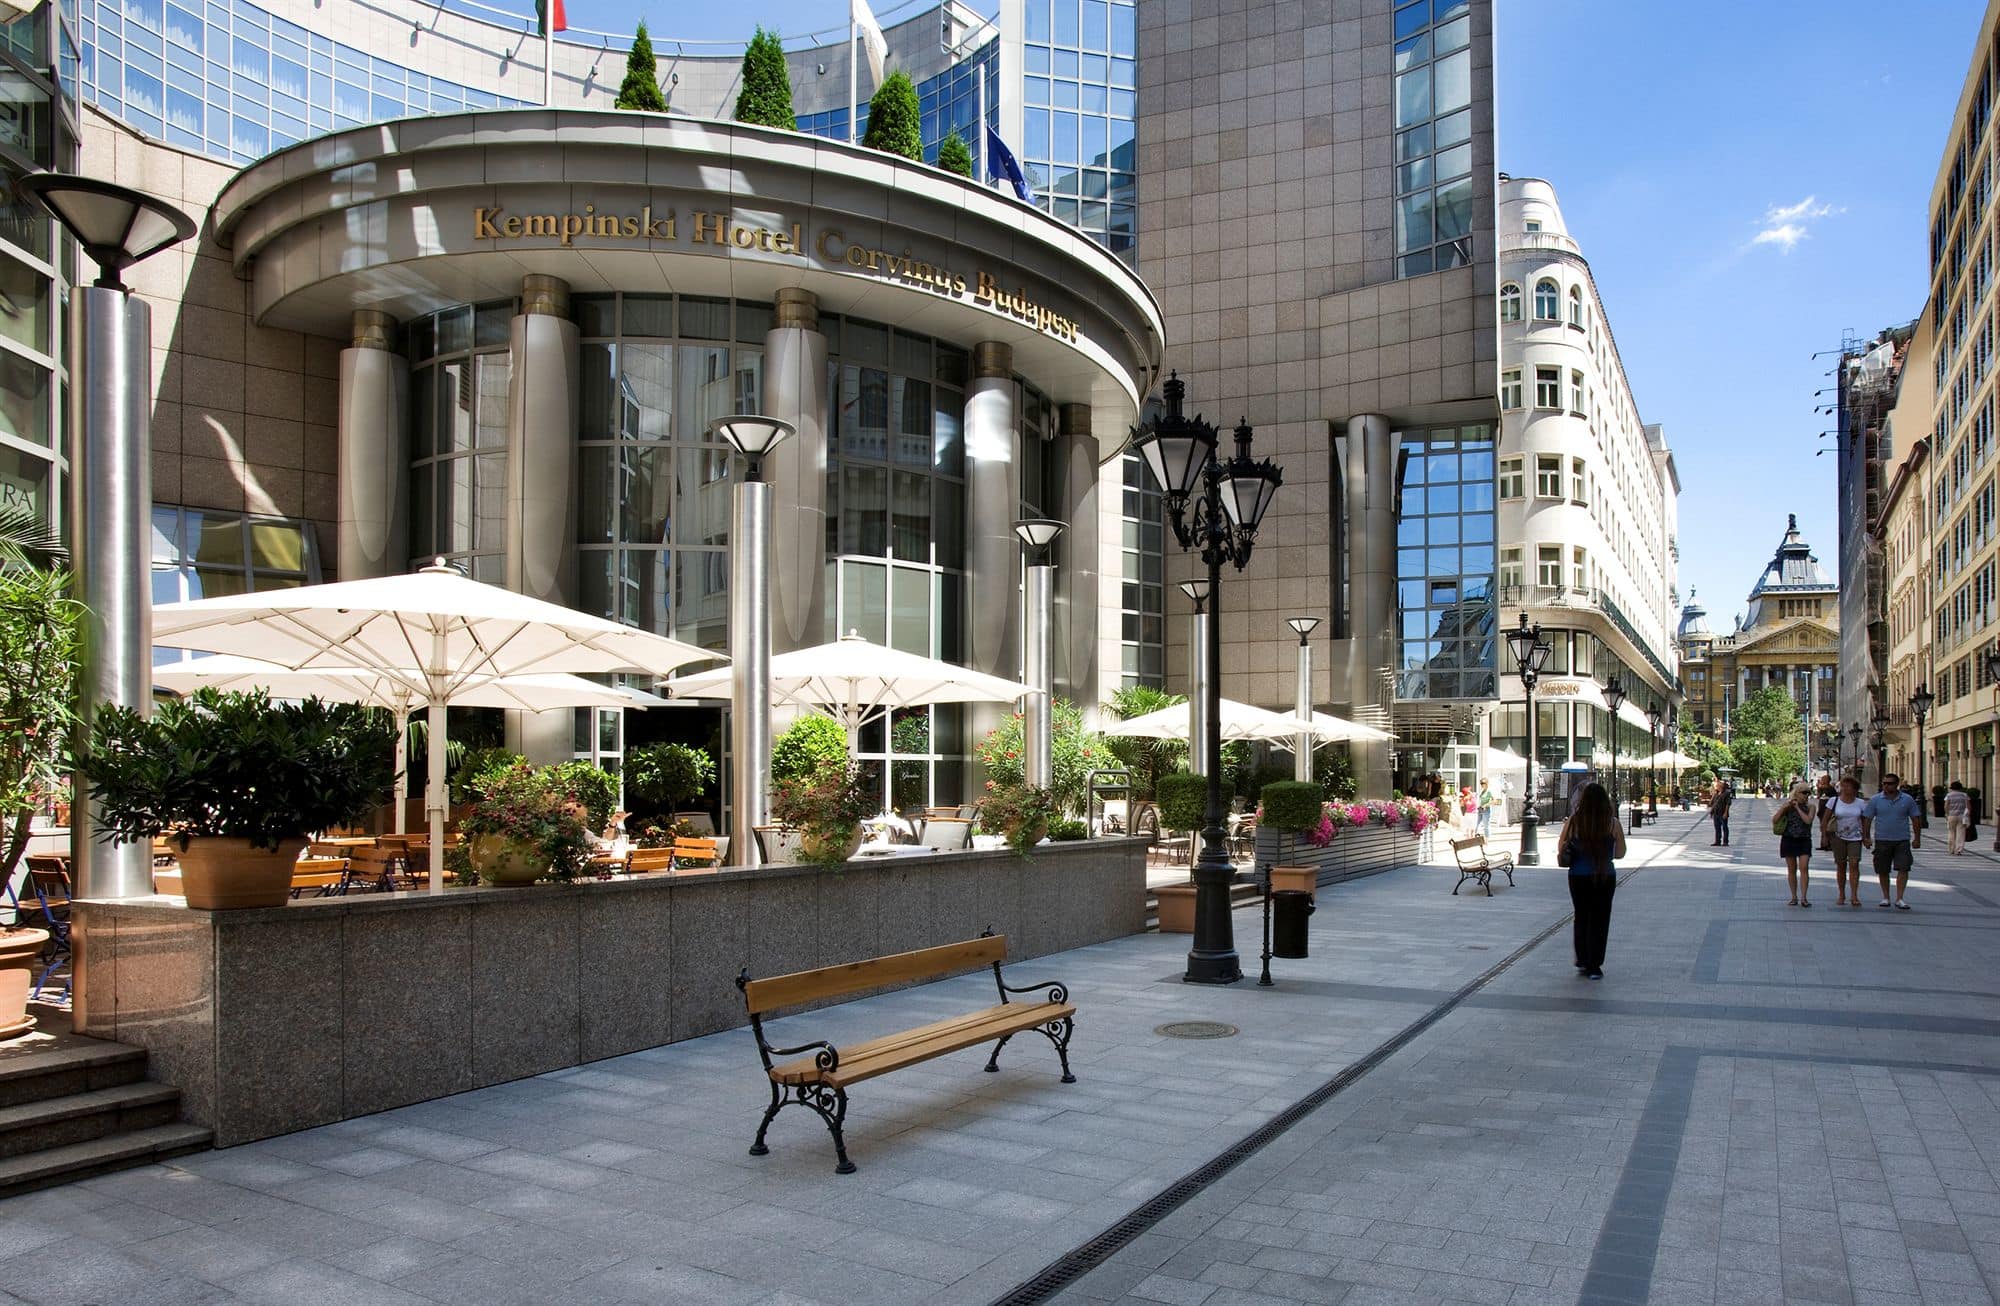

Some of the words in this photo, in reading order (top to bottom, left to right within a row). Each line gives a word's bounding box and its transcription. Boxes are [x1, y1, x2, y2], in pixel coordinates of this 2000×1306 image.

[473, 204, 678, 247] Kempinski
[691, 211, 807, 257] Hotel
[816, 230, 967, 293] Corvinus
[976, 270, 1081, 340] Budapest
[0, 479, 33, 511] RA
